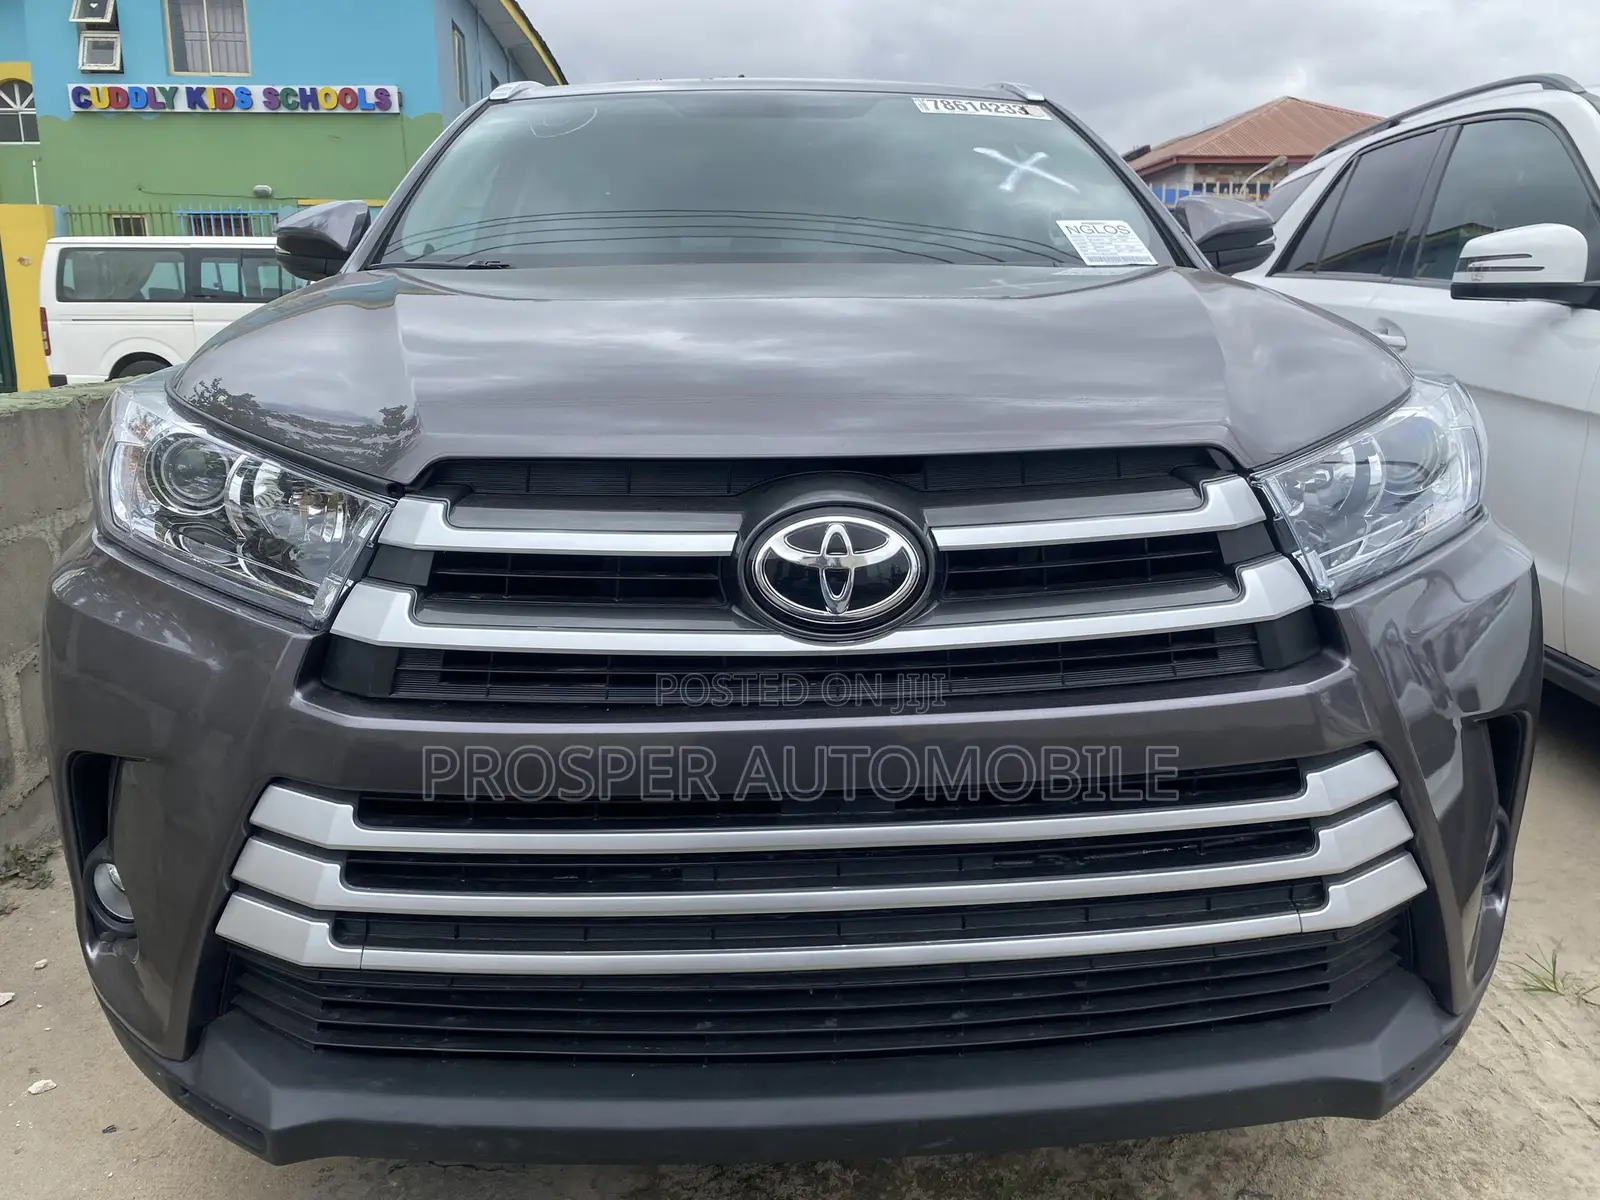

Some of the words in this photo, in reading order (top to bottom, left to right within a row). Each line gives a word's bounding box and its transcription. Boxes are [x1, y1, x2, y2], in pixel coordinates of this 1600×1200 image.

[71, 85, 179, 110] CUDDLY
[186, 86, 253, 110] KIDS
[262, 86, 393, 111] SCHOOLS
[1065, 224, 1131, 235] NGLOS
